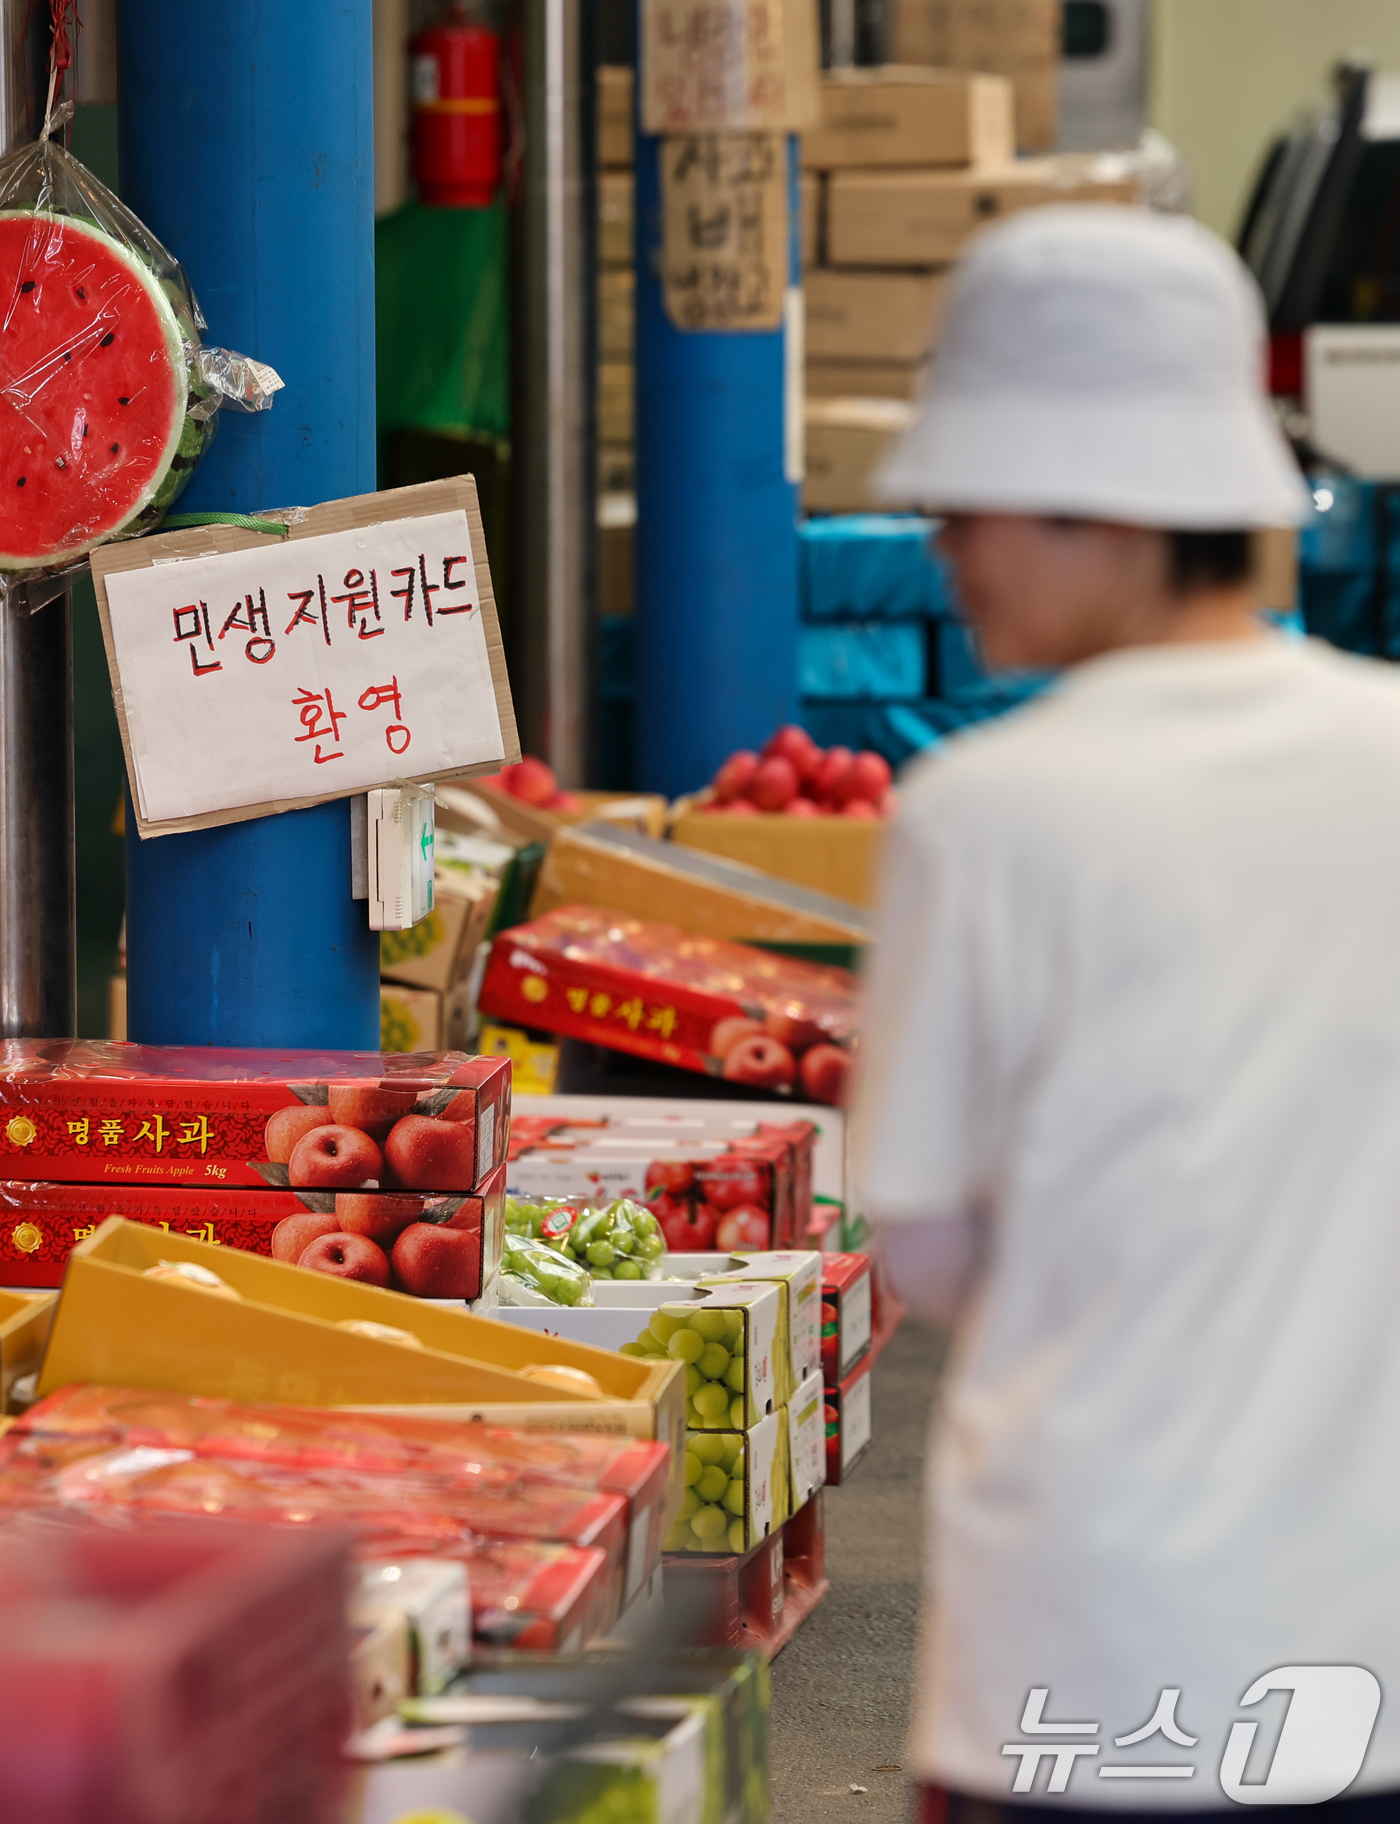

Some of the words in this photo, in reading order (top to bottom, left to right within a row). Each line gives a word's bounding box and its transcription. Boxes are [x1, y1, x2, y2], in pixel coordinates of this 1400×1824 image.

[291, 674, 411, 765] 환영
[104, 1163, 132, 1174] Fresh
[135, 1164, 164, 1175] Fruits
[166, 1165, 195, 1177] Apple
[204, 1164, 227, 1179] 5kg
